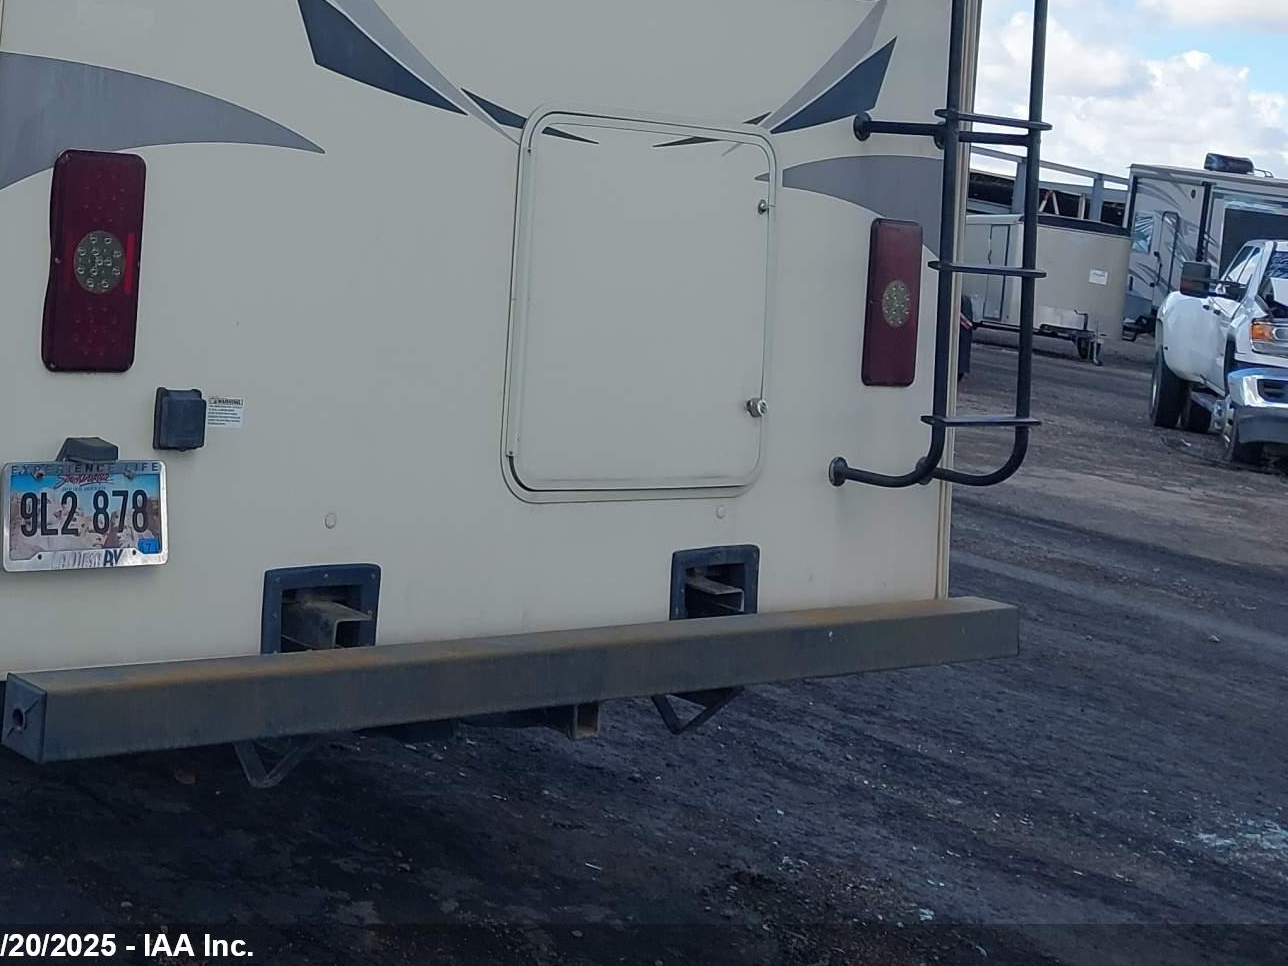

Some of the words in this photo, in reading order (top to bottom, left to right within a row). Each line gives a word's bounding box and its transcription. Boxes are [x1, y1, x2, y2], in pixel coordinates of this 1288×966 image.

[125, 462, 160, 474] LIFE
[20, 491, 79, 537] 9L2
[92, 489, 149, 534] 878
